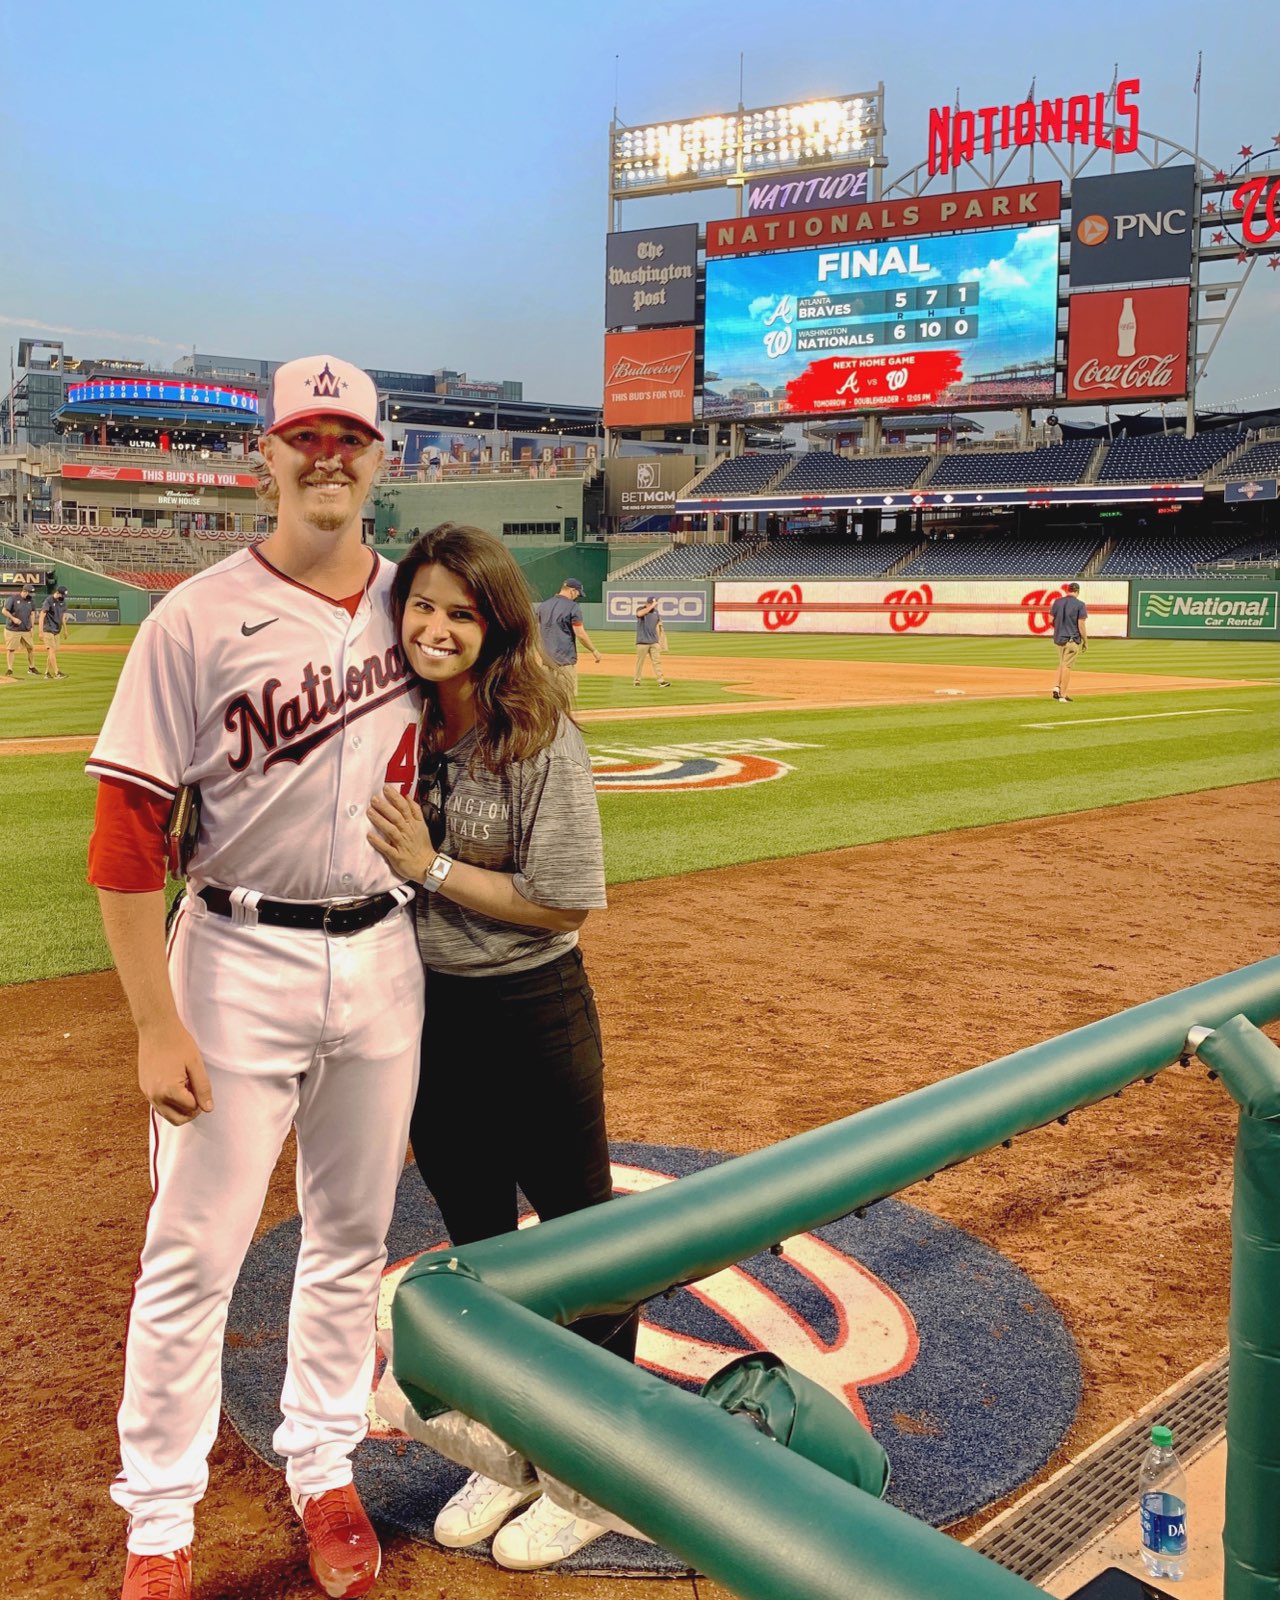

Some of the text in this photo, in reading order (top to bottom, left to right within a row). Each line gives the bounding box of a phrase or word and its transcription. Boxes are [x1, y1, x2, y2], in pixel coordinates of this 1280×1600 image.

[928, 79, 1140, 176] NATIONALS
[749, 171, 868, 211] NATITUDE
[718, 192, 1039, 246] NATIONALS PARK
[1113, 209, 1187, 240] PNC
[636, 241, 664, 260] The
[818, 245, 930, 281] FINAL
[608, 263, 693, 286] Washington
[633, 288, 666, 312] Post
[800, 297, 831, 307] ATLANTA
[895, 287, 967, 308] 5 7 1
[799, 304, 852, 318] BRAVES
[897, 312, 904, 320] R
[959, 307, 965, 315] E
[798, 327, 848, 338] WASHINGTON
[893, 319, 968, 340] 6 10 0
[798, 334, 874, 349] NATIONALS
[612, 362, 682, 379] Budweiser
[833, 356, 915, 370] NEXT HOME GAME
[1073, 353, 1180, 391] Coca-Cola
[611, 389, 686, 402] THIS BUD'S FOR YOU.
[813, 393, 931, 408] TOMORROW DOUBLEHEADER 12:05 PM
[129, 440, 156, 448] ULTRA
[142, 469, 239, 485] THIS BUD'S FOR YOU.
[158, 496, 200, 506] BREW HOUSE
[621, 491, 676, 503] BETMGM
[2, 572, 40, 583] FAN
[610, 596, 703, 617] GECO
[1172, 596, 1269, 616] National
[86, 611, 109, 619] MGM
[1204, 617, 1264, 626] Car Rental
